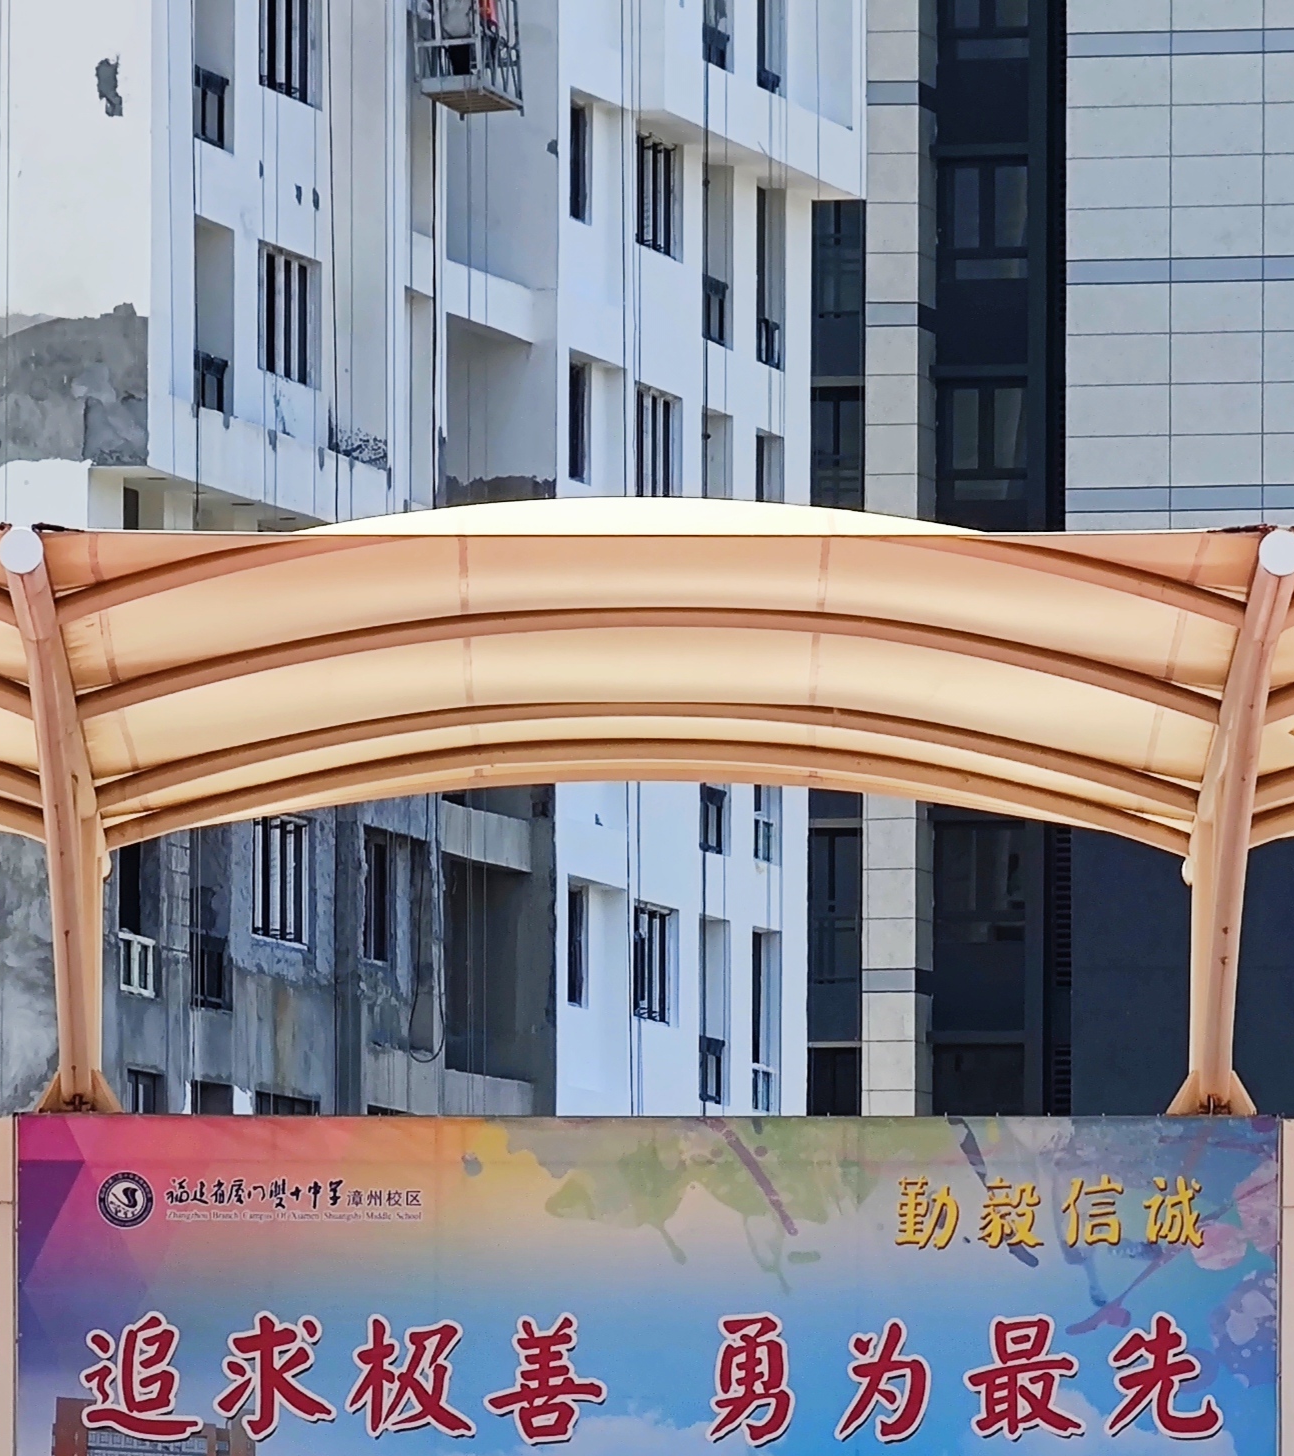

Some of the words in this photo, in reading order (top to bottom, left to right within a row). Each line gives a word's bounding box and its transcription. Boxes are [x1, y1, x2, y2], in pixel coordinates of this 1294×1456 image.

[212, 1210, 239, 1220] Branch
[396, 1210, 422, 1220] School
[82, 1313, 605, 1442] 追求极善
[708, 1314, 1221, 1443] 勇为最先
